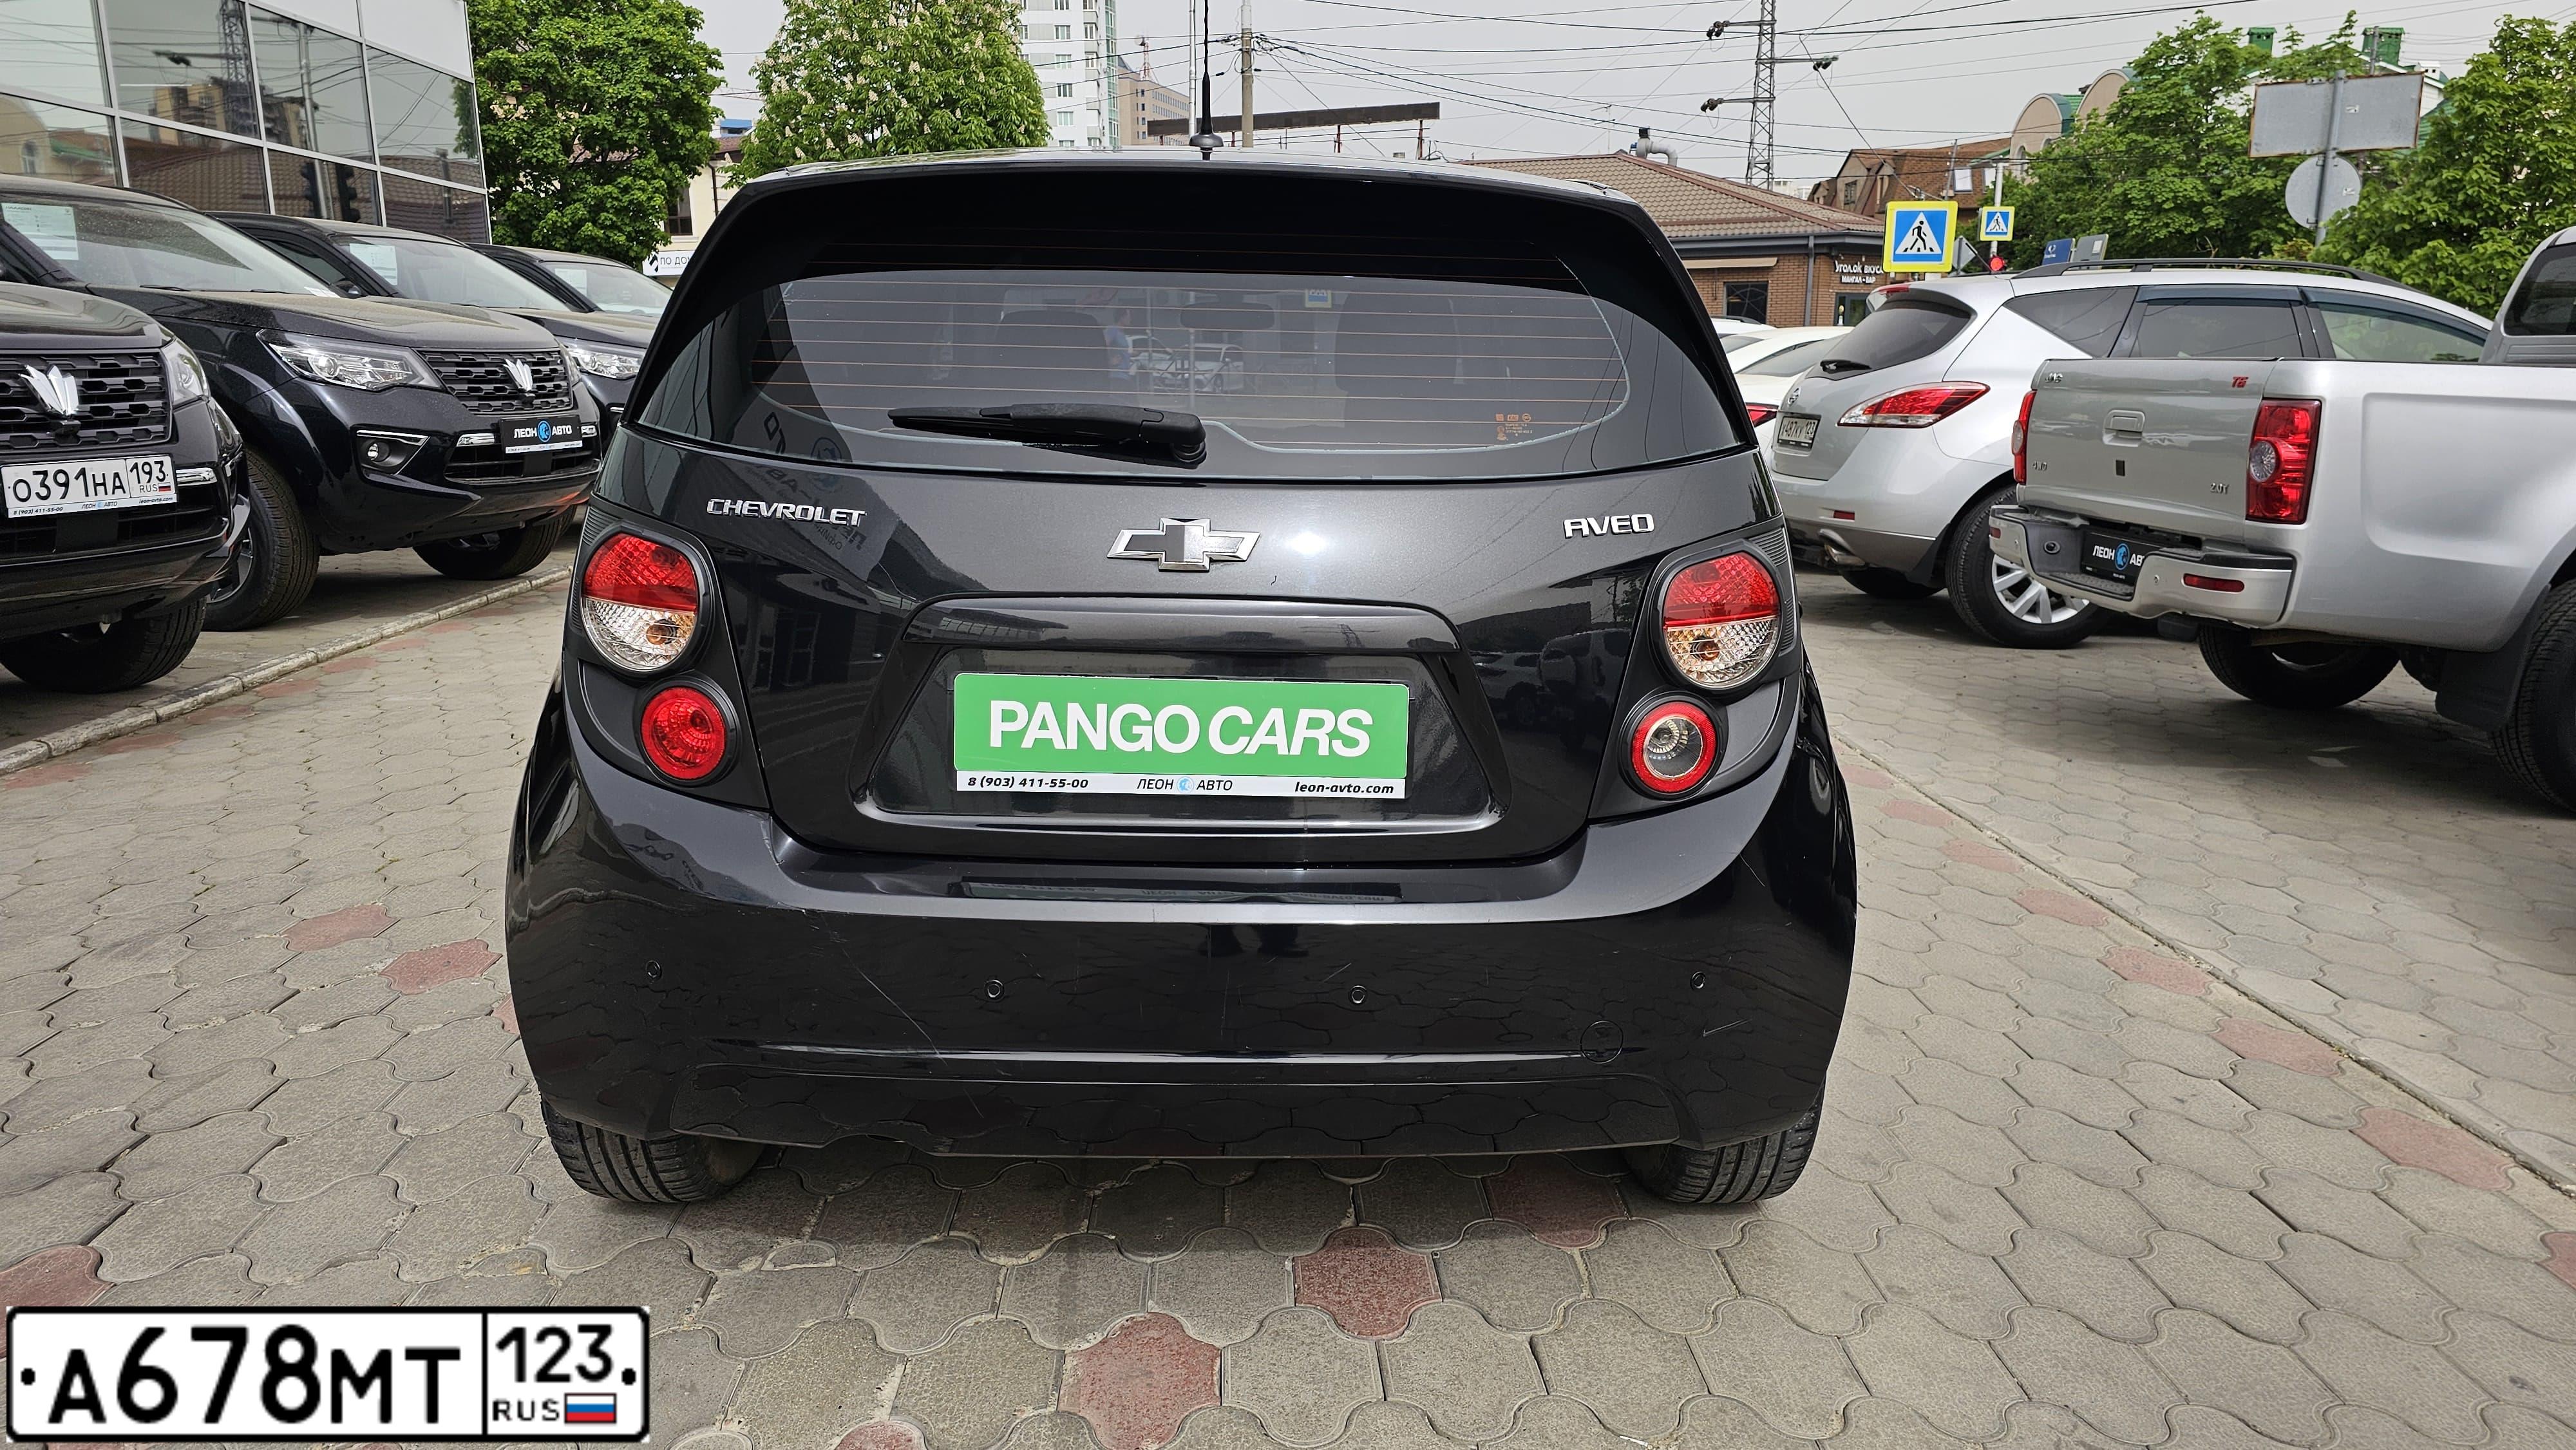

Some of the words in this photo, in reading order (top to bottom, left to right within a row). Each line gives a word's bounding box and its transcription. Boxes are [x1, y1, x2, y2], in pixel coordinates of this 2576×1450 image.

[660, 257, 672, 265] ПО
[674, 256, 690, 266] ДО
[2232, 376, 2249, 388] T6
[514, 427, 538, 438] ЛЕОН
[552, 425, 573, 436] АВТО
[12, 467, 126, 503] О391НА
[129, 460, 166, 484] 193
[139, 484, 158, 493] RUS
[2210, 482, 2230, 494] 2.0T
[706, 498, 867, 527] CHEVROLET
[1563, 514, 1654, 539] AVEO
[2092, 545, 2116, 561] ЛЕОН
[990, 700, 1200, 753] PANGO
[1208, 706, 1374, 757] CARS
[967, 777, 976, 786] 8
[980, 777, 1015, 787] (903)
[1019, 777, 1088, 788] 411-55-00
[1137, 778, 1173, 789] ЛЕОН
[1196, 780, 1233, 791] АВТО
[1294, 781, 1394, 794] leon-avto.com
